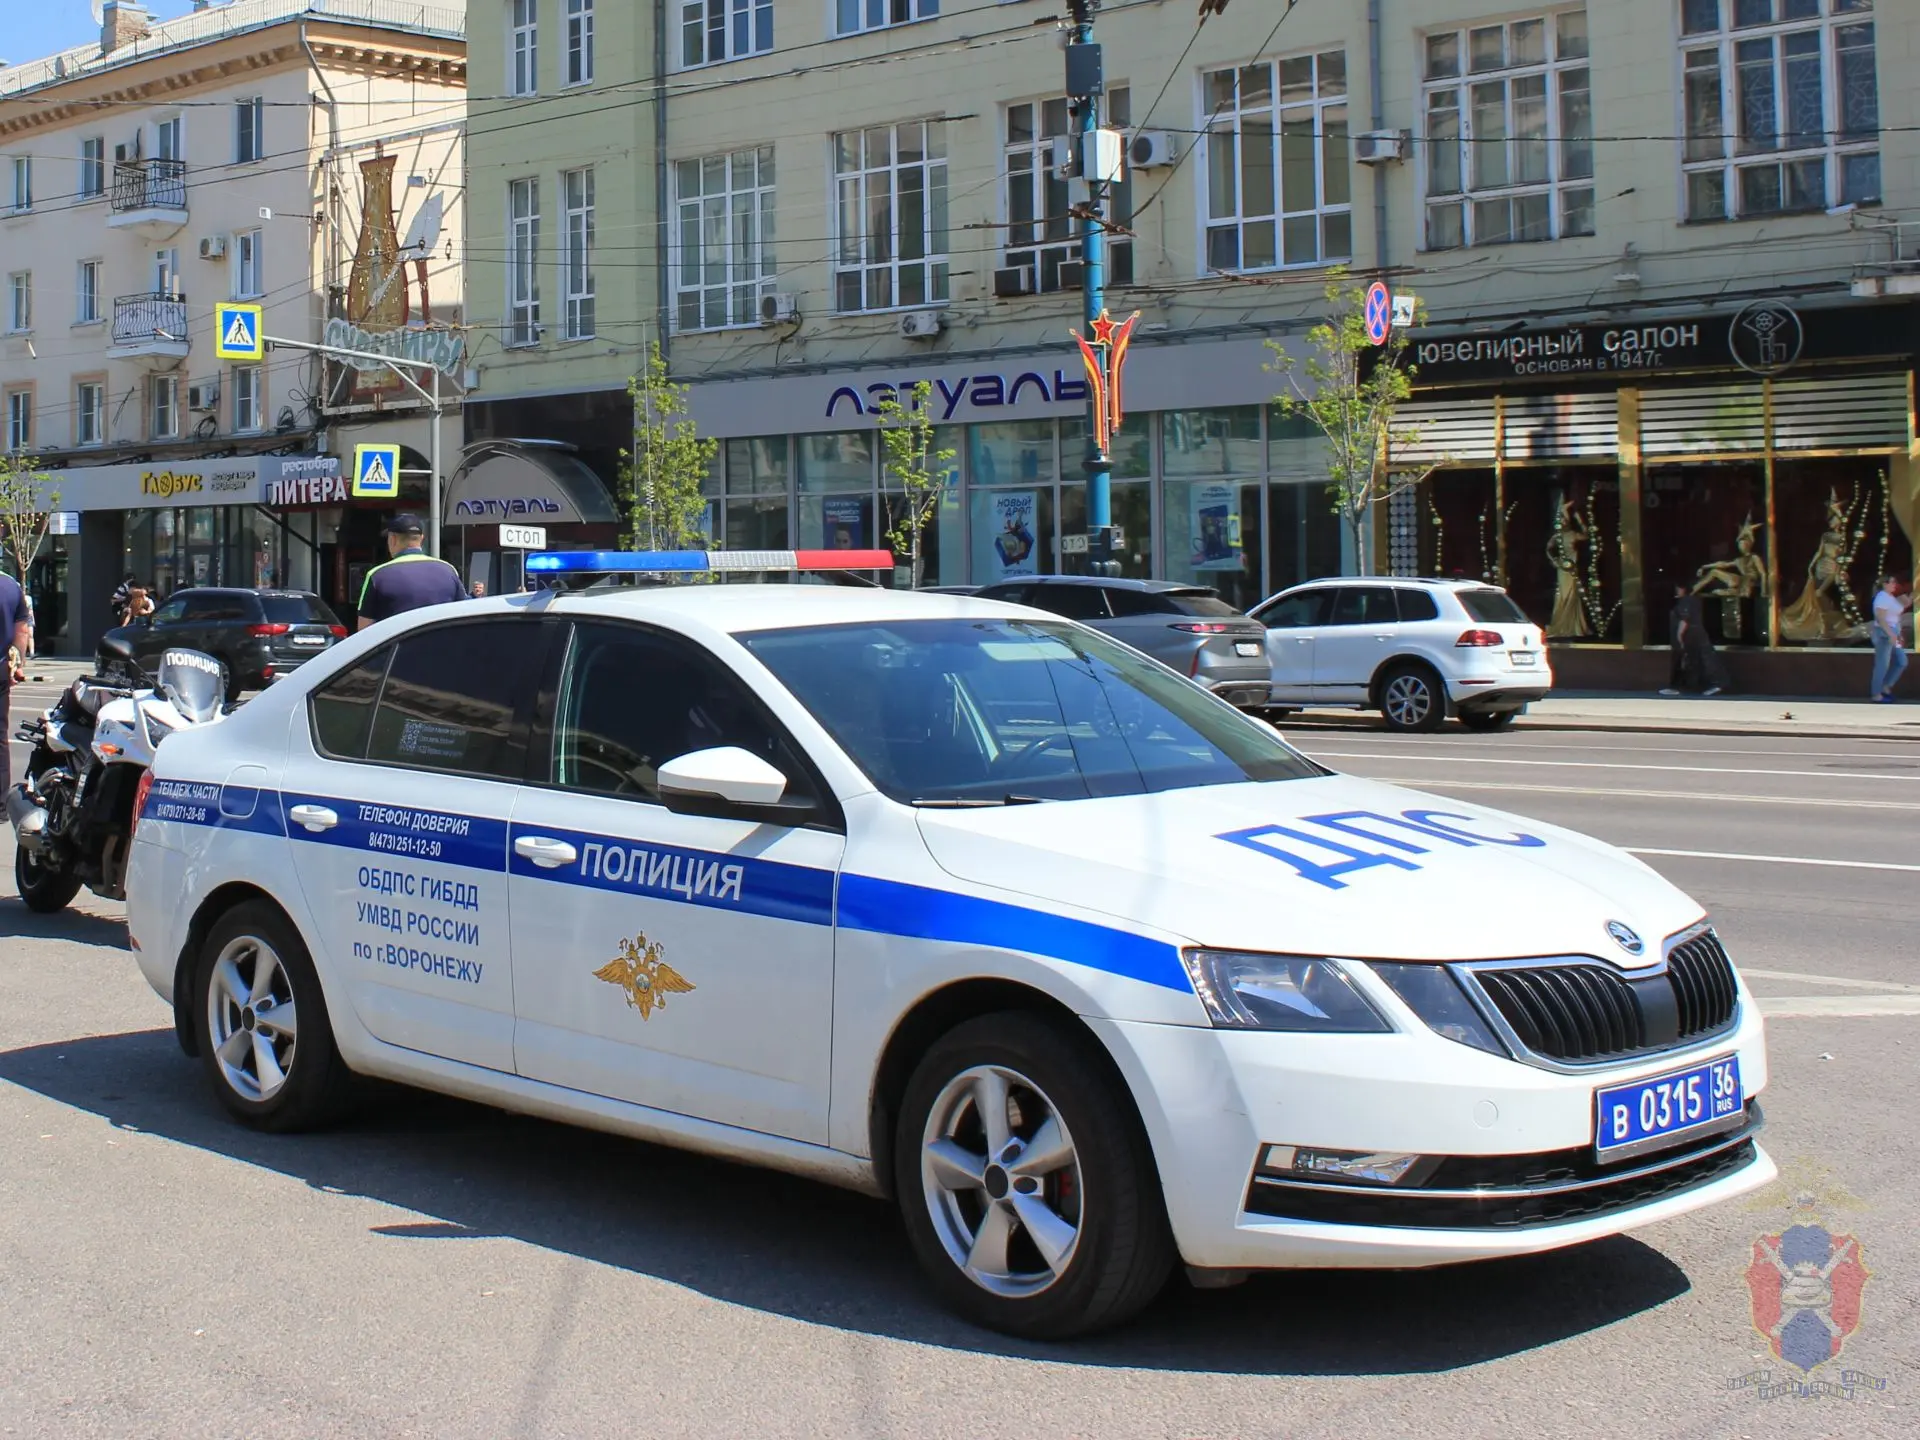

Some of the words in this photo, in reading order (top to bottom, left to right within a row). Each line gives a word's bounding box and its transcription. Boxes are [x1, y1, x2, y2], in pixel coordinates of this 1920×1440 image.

[1602, 324, 1699, 352] салон
[1514, 358, 1593, 375] основан
[1597, 358, 1606, 370] в
[281, 456, 339, 476] рестобар
[270, 475, 348, 505] ЛИТЕРА
[996, 496, 1032, 508] НОВЫЙ
[506, 529, 540, 545] СТОП
[166, 652, 220, 677] ПОЛИЦИЯ
[358, 805, 412, 827] ТЕЛЕФОН
[411, 812, 470, 836] ДОВЕРИЯ
[1210, 809, 1547, 890] ДПС
[580, 842, 744, 901] ПОЛИЦИЯ
[358, 866, 416, 896] ОБДПС
[421, 876, 479, 911] ГИБДД
[356, 900, 403, 934] УМВД
[407, 915, 480, 947] РОССИИ
[353, 941, 373, 959] по
[1713, 1063, 1735, 1100] 36
[1639, 1075, 1701, 1132] 0315
[1716, 1098, 1733, 1113] RUS
